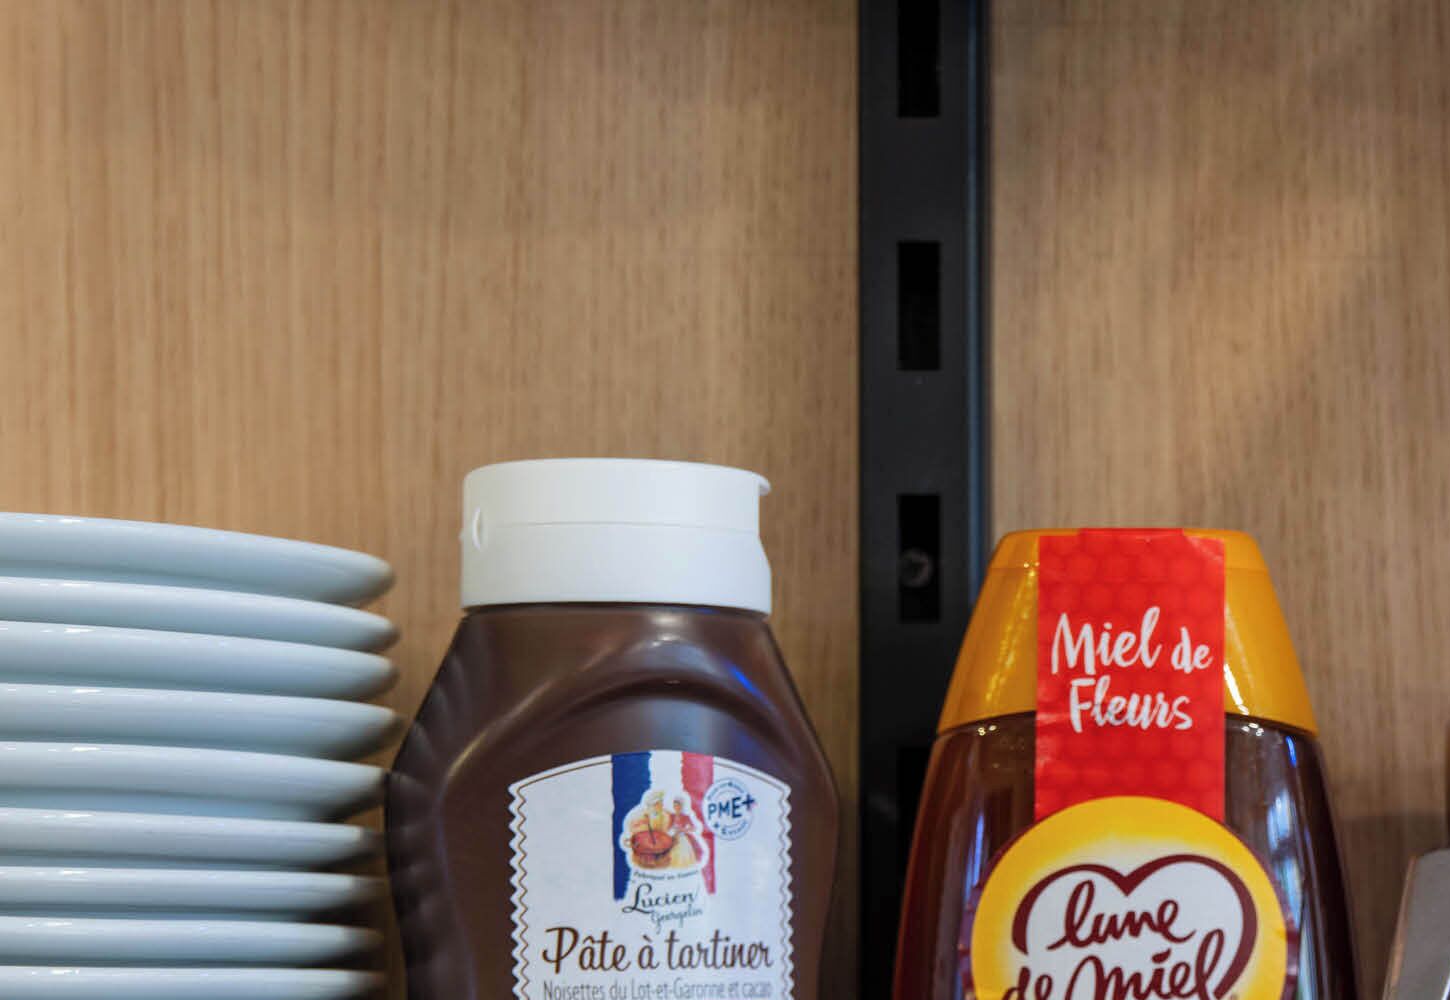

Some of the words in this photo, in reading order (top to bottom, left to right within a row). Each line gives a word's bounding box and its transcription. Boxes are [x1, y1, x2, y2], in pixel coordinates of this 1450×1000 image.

[1051, 605, 1163, 676] Miel
[1171, 626, 1214, 674] de
[1069, 674, 1193, 734] Fleurs
[622, 883, 695, 914] Lucien
[1046, 879, 1198, 950] lune
[542, 927, 631, 975] Pâte
[638, 933, 660, 971] à
[664, 928, 774, 971] tartiner
[543, 979, 606, 1000] Noisettes
[609, 979, 628, 1000] du
[631, 976, 725, 1000] Lot-et-Garonne
